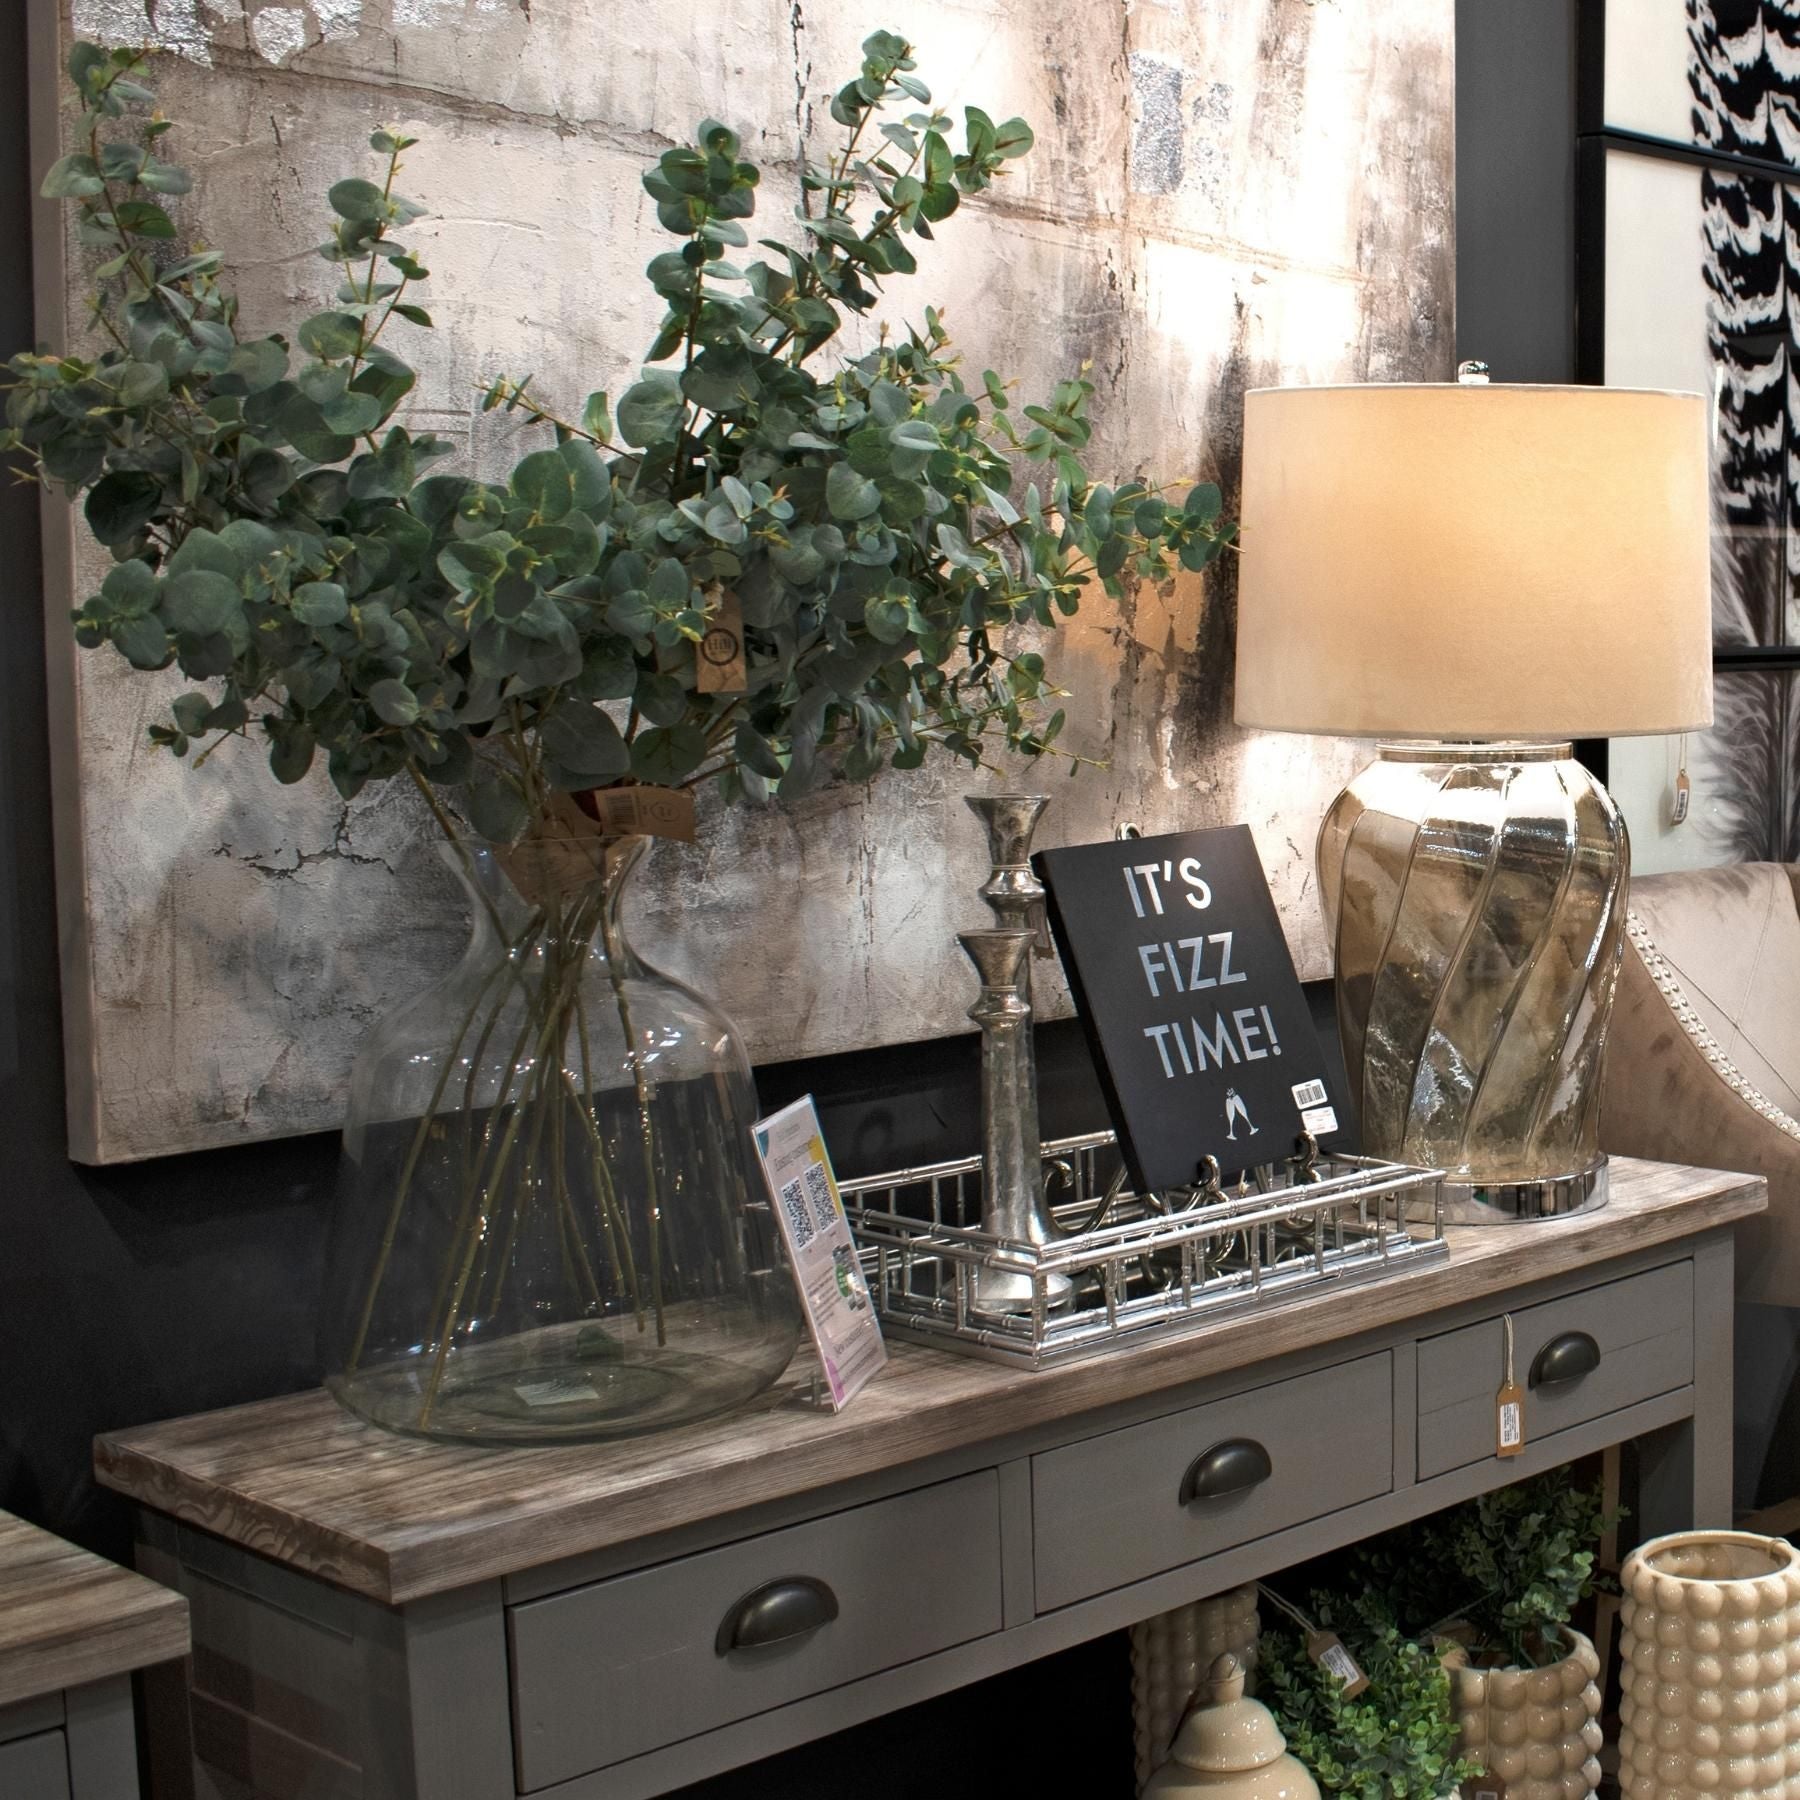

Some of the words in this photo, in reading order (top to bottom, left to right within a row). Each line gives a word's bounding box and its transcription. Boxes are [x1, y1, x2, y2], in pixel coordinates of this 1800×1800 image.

[1123, 857, 1212, 918] IT'S
[1138, 931, 1248, 997] FIZZ
[1143, 1004, 1282, 1078] TIME!
